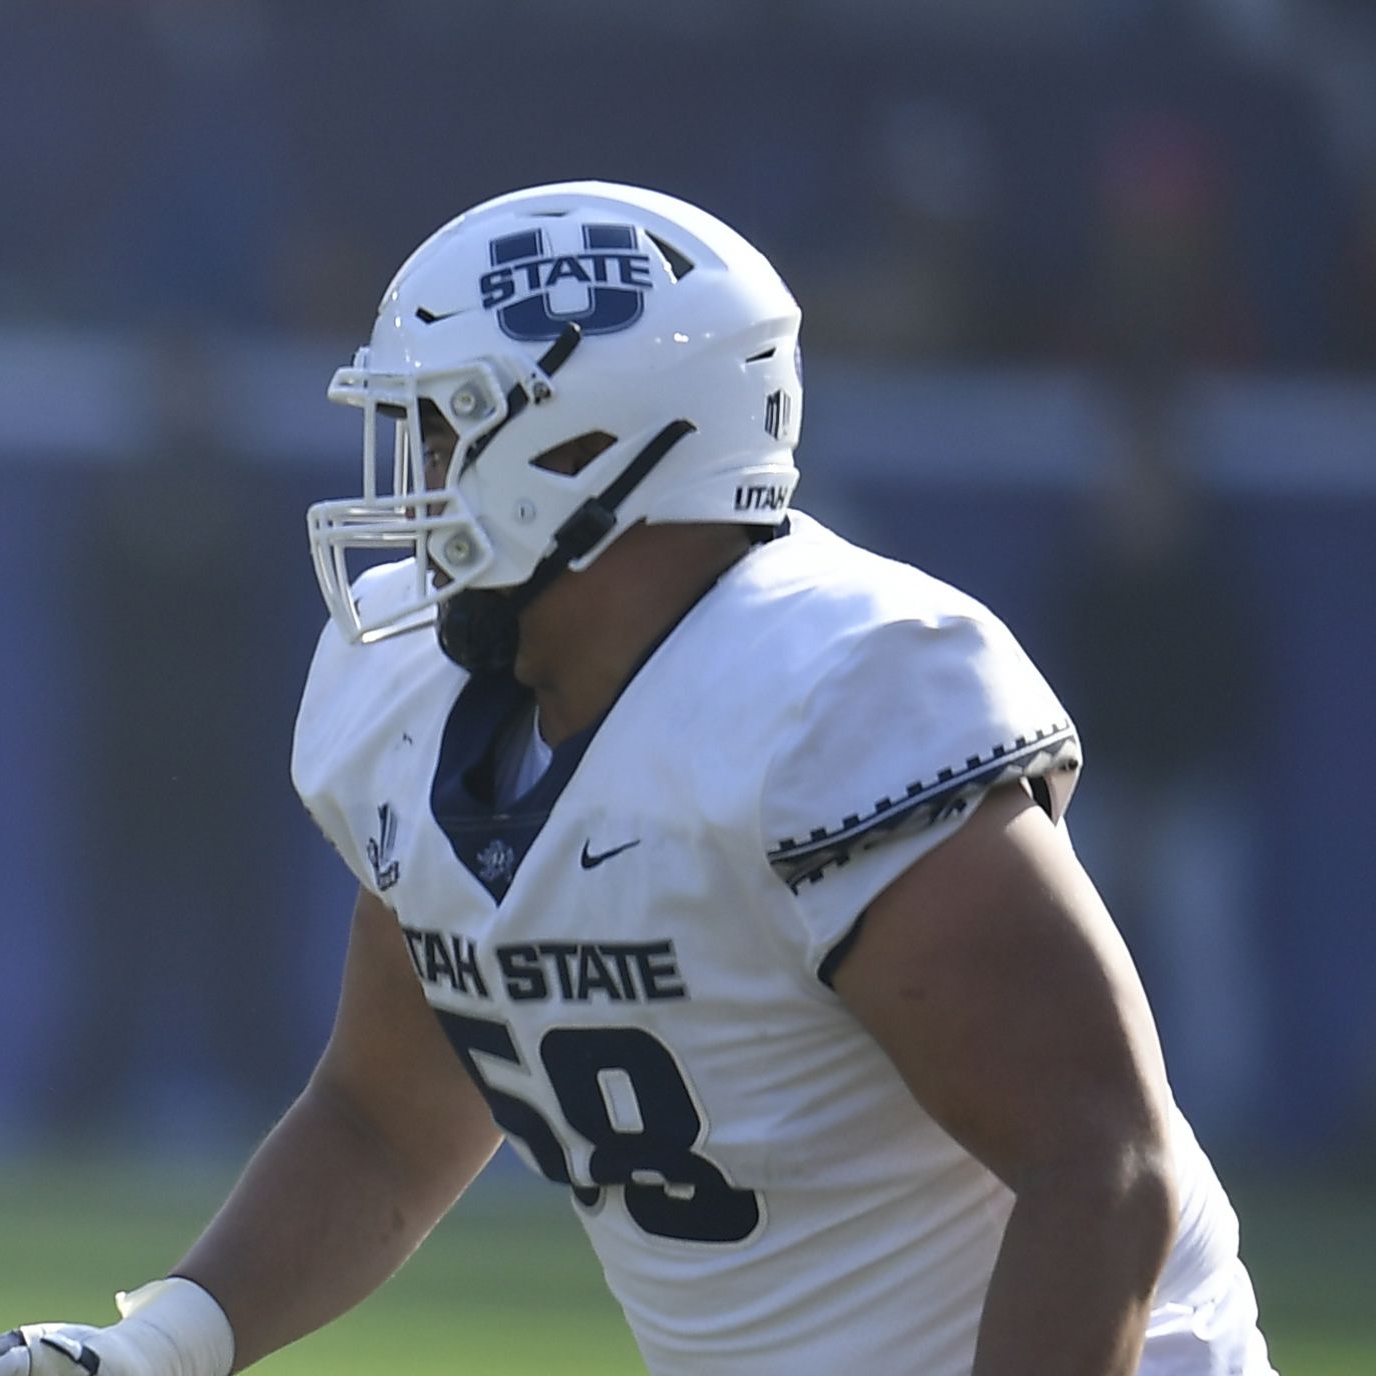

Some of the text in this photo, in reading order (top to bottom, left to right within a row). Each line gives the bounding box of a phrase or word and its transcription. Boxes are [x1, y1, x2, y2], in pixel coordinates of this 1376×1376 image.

[479, 253, 654, 310] STATE
[734, 485, 789, 511] UTAH
[401, 926, 687, 1001] TAH STATE
[432, 1005, 765, 1244] 58
